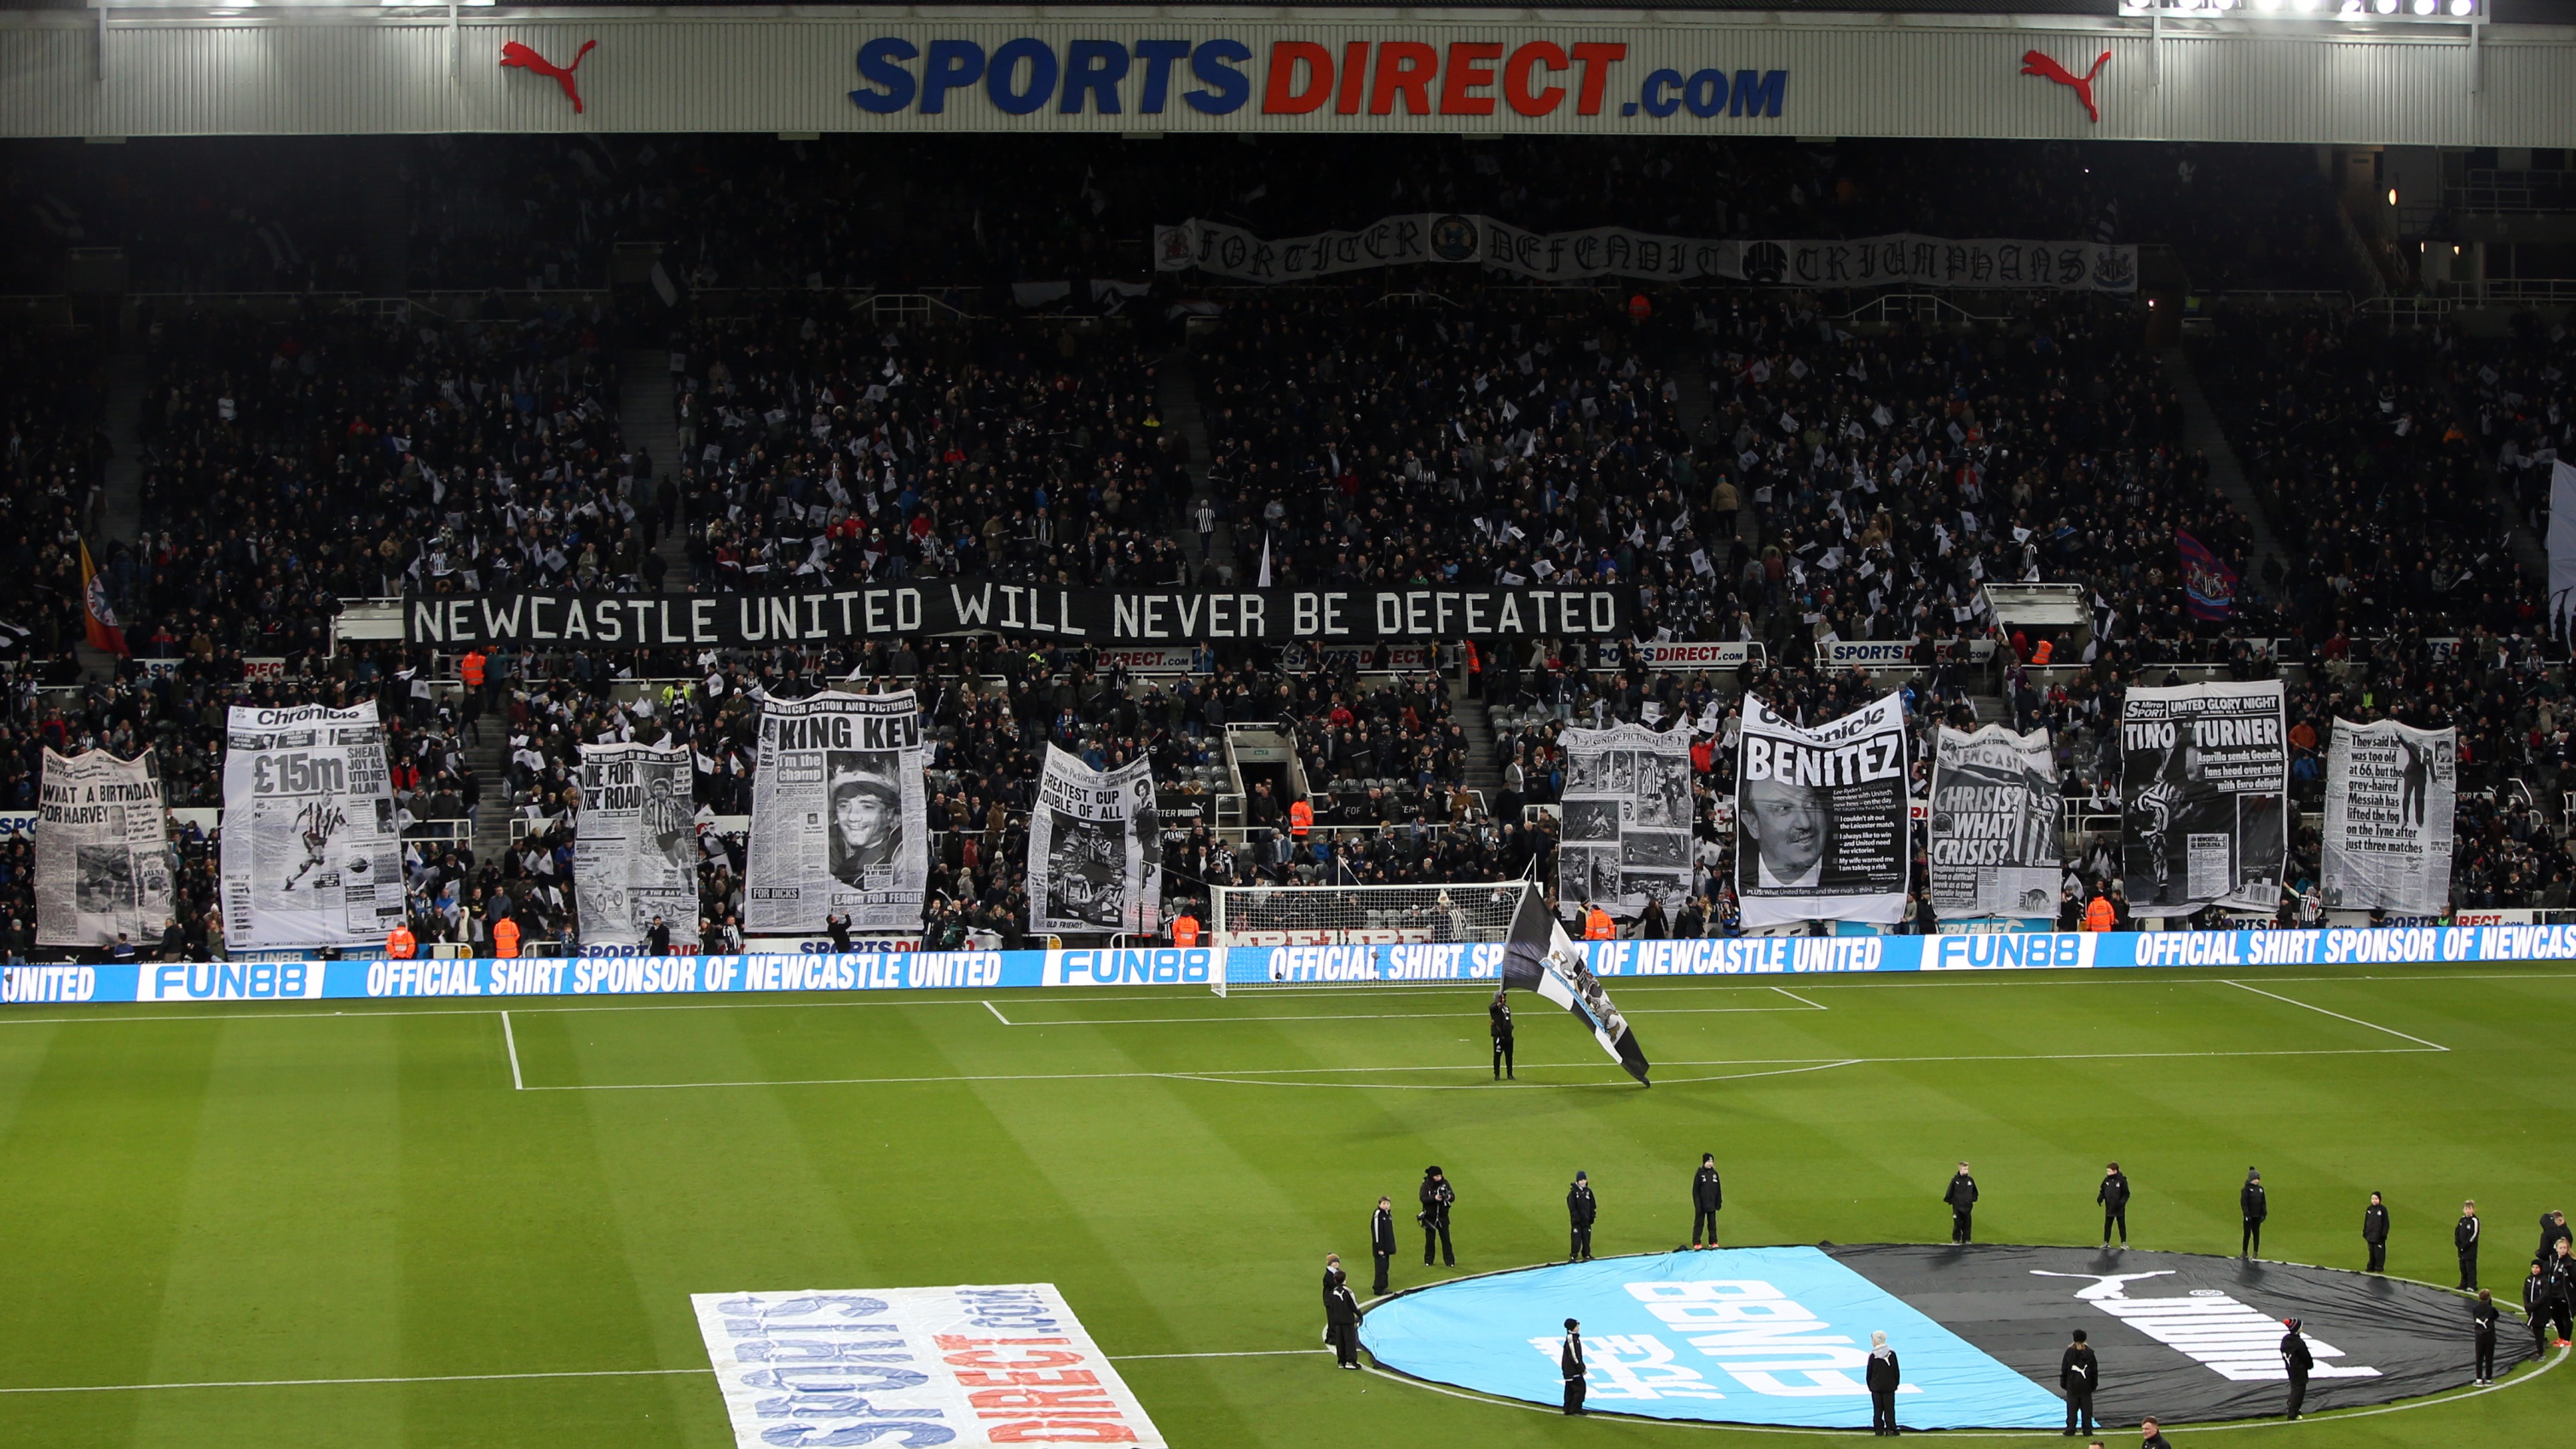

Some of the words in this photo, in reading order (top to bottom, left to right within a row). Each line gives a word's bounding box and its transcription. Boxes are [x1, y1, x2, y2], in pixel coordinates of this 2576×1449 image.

[848, 37, 1787, 118] SPORTSDIRECT.COM
[1198, 221, 1422, 278] FORTITER
[1488, 224, 1720, 274] DEFENDIT
[1796, 240, 2087, 284] TRIUMPHANS
[414, 593, 719, 644] NEWCASTLE
[741, 587, 923, 638] UNITED
[950, 583, 1086, 636] WILL
[1114, 593, 1266, 638] NEVER
[1294, 592, 1349, 635] BE
[1376, 590, 1617, 635] DEFEATED
[1064, 651, 1188, 667] DIRECT.COM
[1599, 646, 1743, 662] POTSDIRECT.COM
[809, 701, 843, 713] ACTION
[845, 702, 866, 712] AND
[869, 699, 914, 713] PICTURES
[2141, 701, 2163, 709] Mirror
[2207, 698, 2242, 710] GLORY
[2244, 696, 2277, 709] NIGHT
[779, 717, 852, 750] KING
[863, 714, 919, 748] KEV
[1759, 707, 1885, 742] Conicle
[1623, 732, 1661, 748] PICTORIAL
[2125, 721, 2176, 751] TINO
[2193, 718, 2279, 748] TURNER
[2352, 734, 2372, 748] They
[2372, 736, 2388, 748] said
[2390, 736, 2400, 748] he
[348, 747, 380, 759] SHEAR
[637, 752, 646, 760] go
[778, 755, 797, 767] I'm
[800, 754, 821, 766] the
[1747, 734, 1901, 787] BENITEZ
[2197, 751, 2227, 764] Asprilla
[2227, 750, 2250, 760] sends
[2251, 748, 2283, 759] Geordie
[2351, 752, 2367, 762] was
[2369, 752, 2383, 762] too
[2384, 750, 2397, 763] old
[348, 759, 367, 771] JOY
[371, 758, 384, 769] AS
[1049, 755, 1068, 775] Sunday
[1069, 766, 1099, 785] Pictorial
[2204, 767, 2221, 776] fans
[2222, 765, 2243, 776] head
[2244, 765, 2261, 774] over
[2262, 764, 2283, 773] heels
[2348, 765, 2358, 776] at
[2359, 764, 2374, 776] 66,
[2375, 765, 2388, 776] but
[2389, 765, 2404, 778] the
[254, 753, 344, 793] £15m
[349, 771, 369, 782] UTD
[370, 770, 387, 781] NET
[585, 765, 604, 788] ONE
[609, 761, 634, 784] FOR
[778, 769, 822, 782] champ
[43, 783, 78, 804] WHAT
[86, 786, 95, 803] A
[100, 780, 159, 802] BIRTHDAY
[349, 782, 379, 794] ALAN
[1844, 786, 1862, 796] Ryder's
[1863, 782, 1893, 790] EXCLUSIVE
[2217, 780, 2235, 791] with
[2237, 779, 2254, 788] Euro
[2255, 777, 2282, 790] delight
[2348, 778, 2398, 793] grey-haired
[582, 789, 604, 811] THE
[604, 786, 641, 811] ROAD
[1096, 789, 1120, 805] CUP
[1871, 788, 1893, 798] United's
[1934, 786, 2024, 812] CHRISIS?
[2348, 792, 2384, 807] Messiah
[2385, 794, 2400, 807] has
[1040, 789, 1071, 813] OUBLE
[1078, 804, 1093, 818] OF
[1100, 805, 1123, 819] ALL
[38, 803, 61, 823] FOR
[64, 805, 108, 824] HARVEY
[2347, 806, 2371, 820] lifted
[2372, 808, 2385, 822] the
[2387, 809, 2400, 824] fog
[1953, 812, 2013, 839] WHAT
[2346, 825, 2357, 835] on
[2359, 823, 2373, 835] the
[2375, 823, 2394, 839] Tyne
[2395, 824, 2417, 838] after
[1933, 839, 2009, 865] CRISIS?
[2345, 837, 2362, 852] just
[2364, 838, 2386, 852] three
[2388, 840, 2423, 854] matches
[754, 888, 770, 898] FOR
[771, 888, 798, 898] DICKS
[868, 892, 887, 903] FOR
[888, 892, 923, 903] FERGIE
[1955, 889, 1974, 898] legend
[1, 966, 95, 1002] UNITED
[155, 964, 307, 998] FUN88
[367, 961, 488, 996] OFFICIAL
[492, 958, 565, 995] SHIRT
[574, 955, 695, 993] SPONSOR
[704, 955, 739, 990] OF
[746, 952, 904, 990] NEWCASTLE
[909, 951, 1002, 987] UNITED
[1060, 950, 1210, 984] FUN88
[1269, 944, 1381, 982] OFFICIAL
[1387, 943, 1462, 980] SHIRT
[1597, 942, 1632, 976] OF
[1637, 938, 1786, 974] NEWCASTLE
[1793, 937, 1882, 972] UNITED
[1939, 936, 2078, 967] FUN88
[2135, 932, 2241, 966] OFFICIAL
[2248, 930, 2321, 964] SHIRT
[2325, 928, 2435, 963] SPONSOR
[2443, 927, 2475, 961] OF
[1622, 1279, 1924, 1396] FUN88
[716, 1295, 956, 1449] SPORTS
